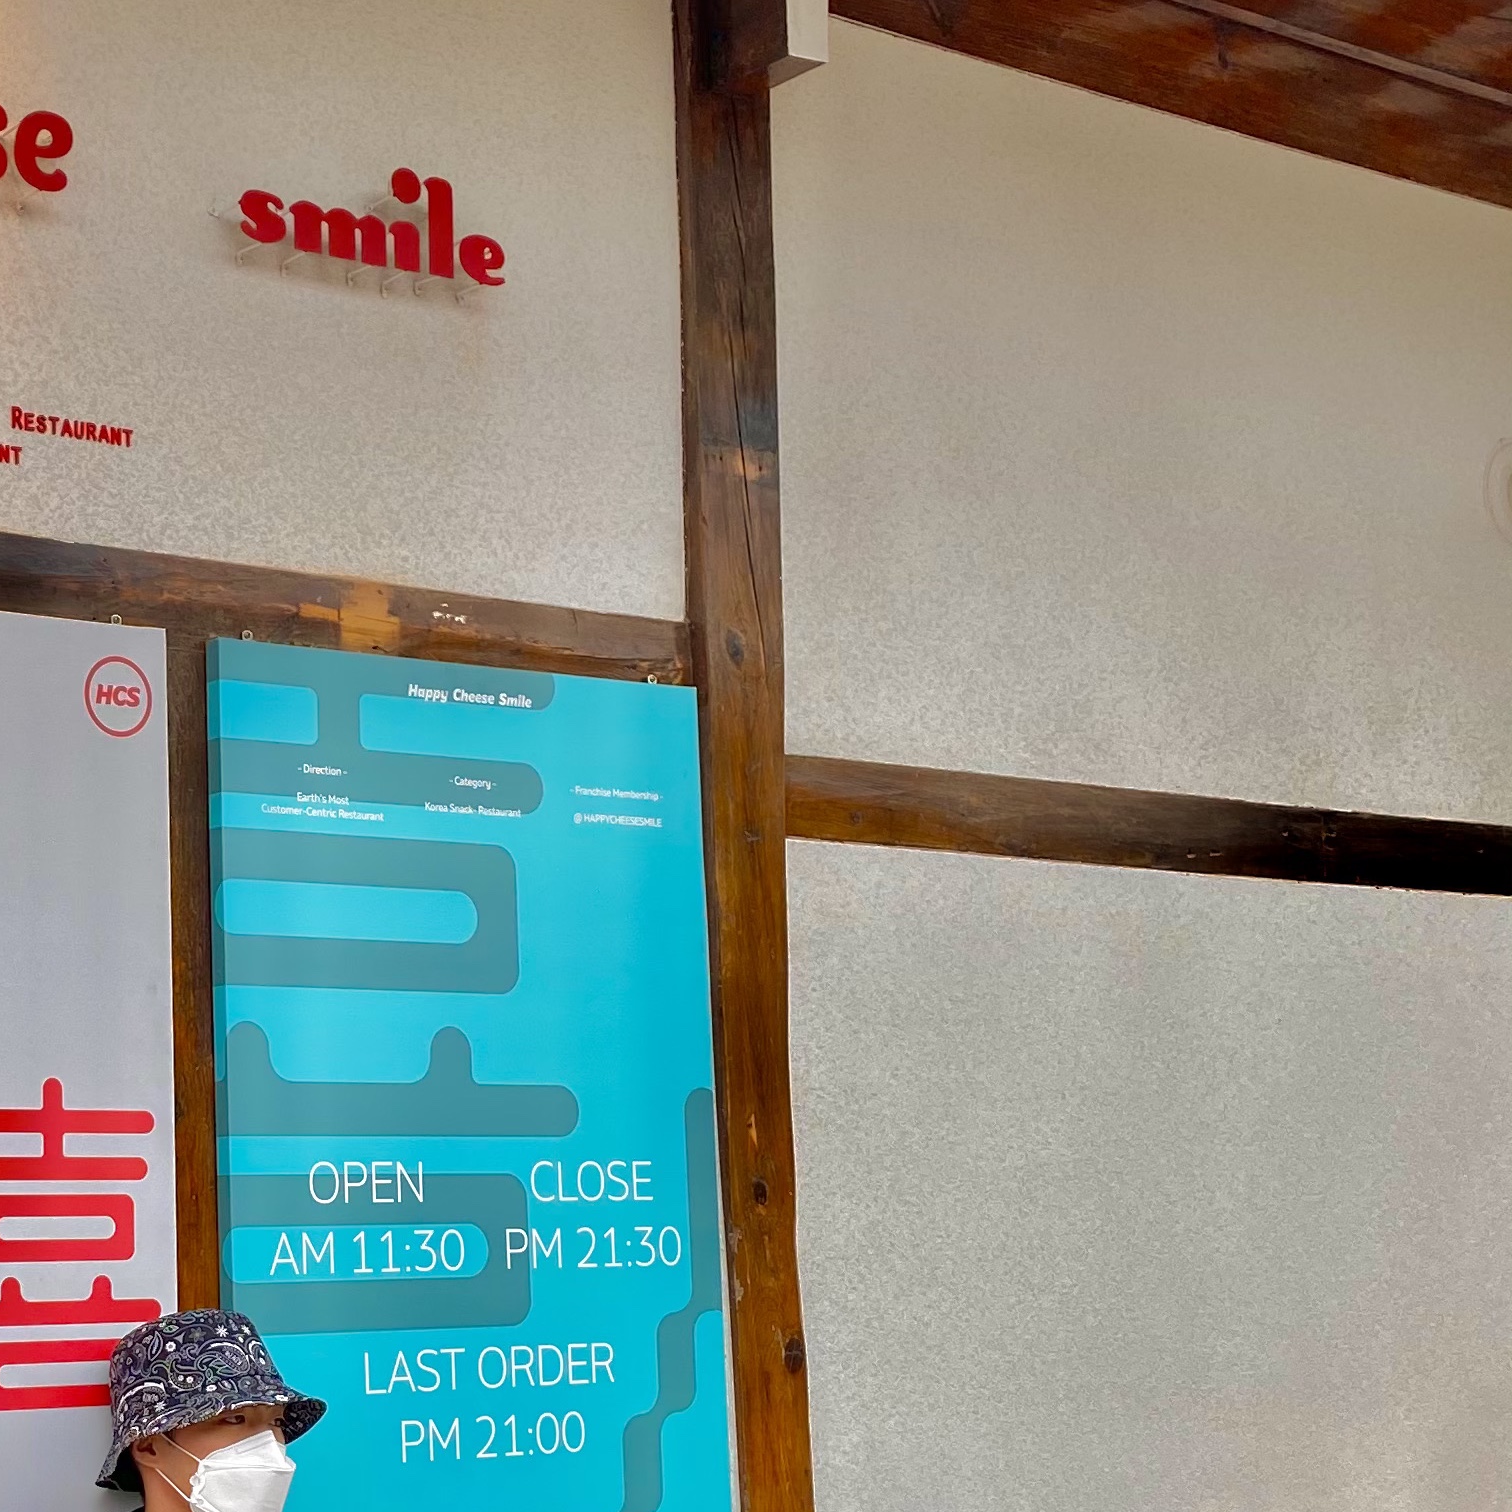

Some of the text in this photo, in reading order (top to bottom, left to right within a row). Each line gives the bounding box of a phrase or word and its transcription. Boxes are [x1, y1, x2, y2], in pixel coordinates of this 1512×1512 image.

[238, 167, 506, 286] smile
[96, 684, 140, 707] HCS
[408, 684, 532, 708] Happy Cheese Smile
[303, 764, 342, 776] Direction
[454, 776, 492, 790] Category
[261, 803, 384, 822] Customer-Centric Restaurant
[296, 792, 349, 805] Earth's Most
[308, 1160, 424, 1204] OPEN
[530, 1159, 655, 1203] CLOSE
[269, 1228, 466, 1276] AM 11:30
[505, 1225, 683, 1271] PM 21:30
[363, 1341, 616, 1397] LAST ORDER
[400, 1410, 587, 1465] PM 21:00
